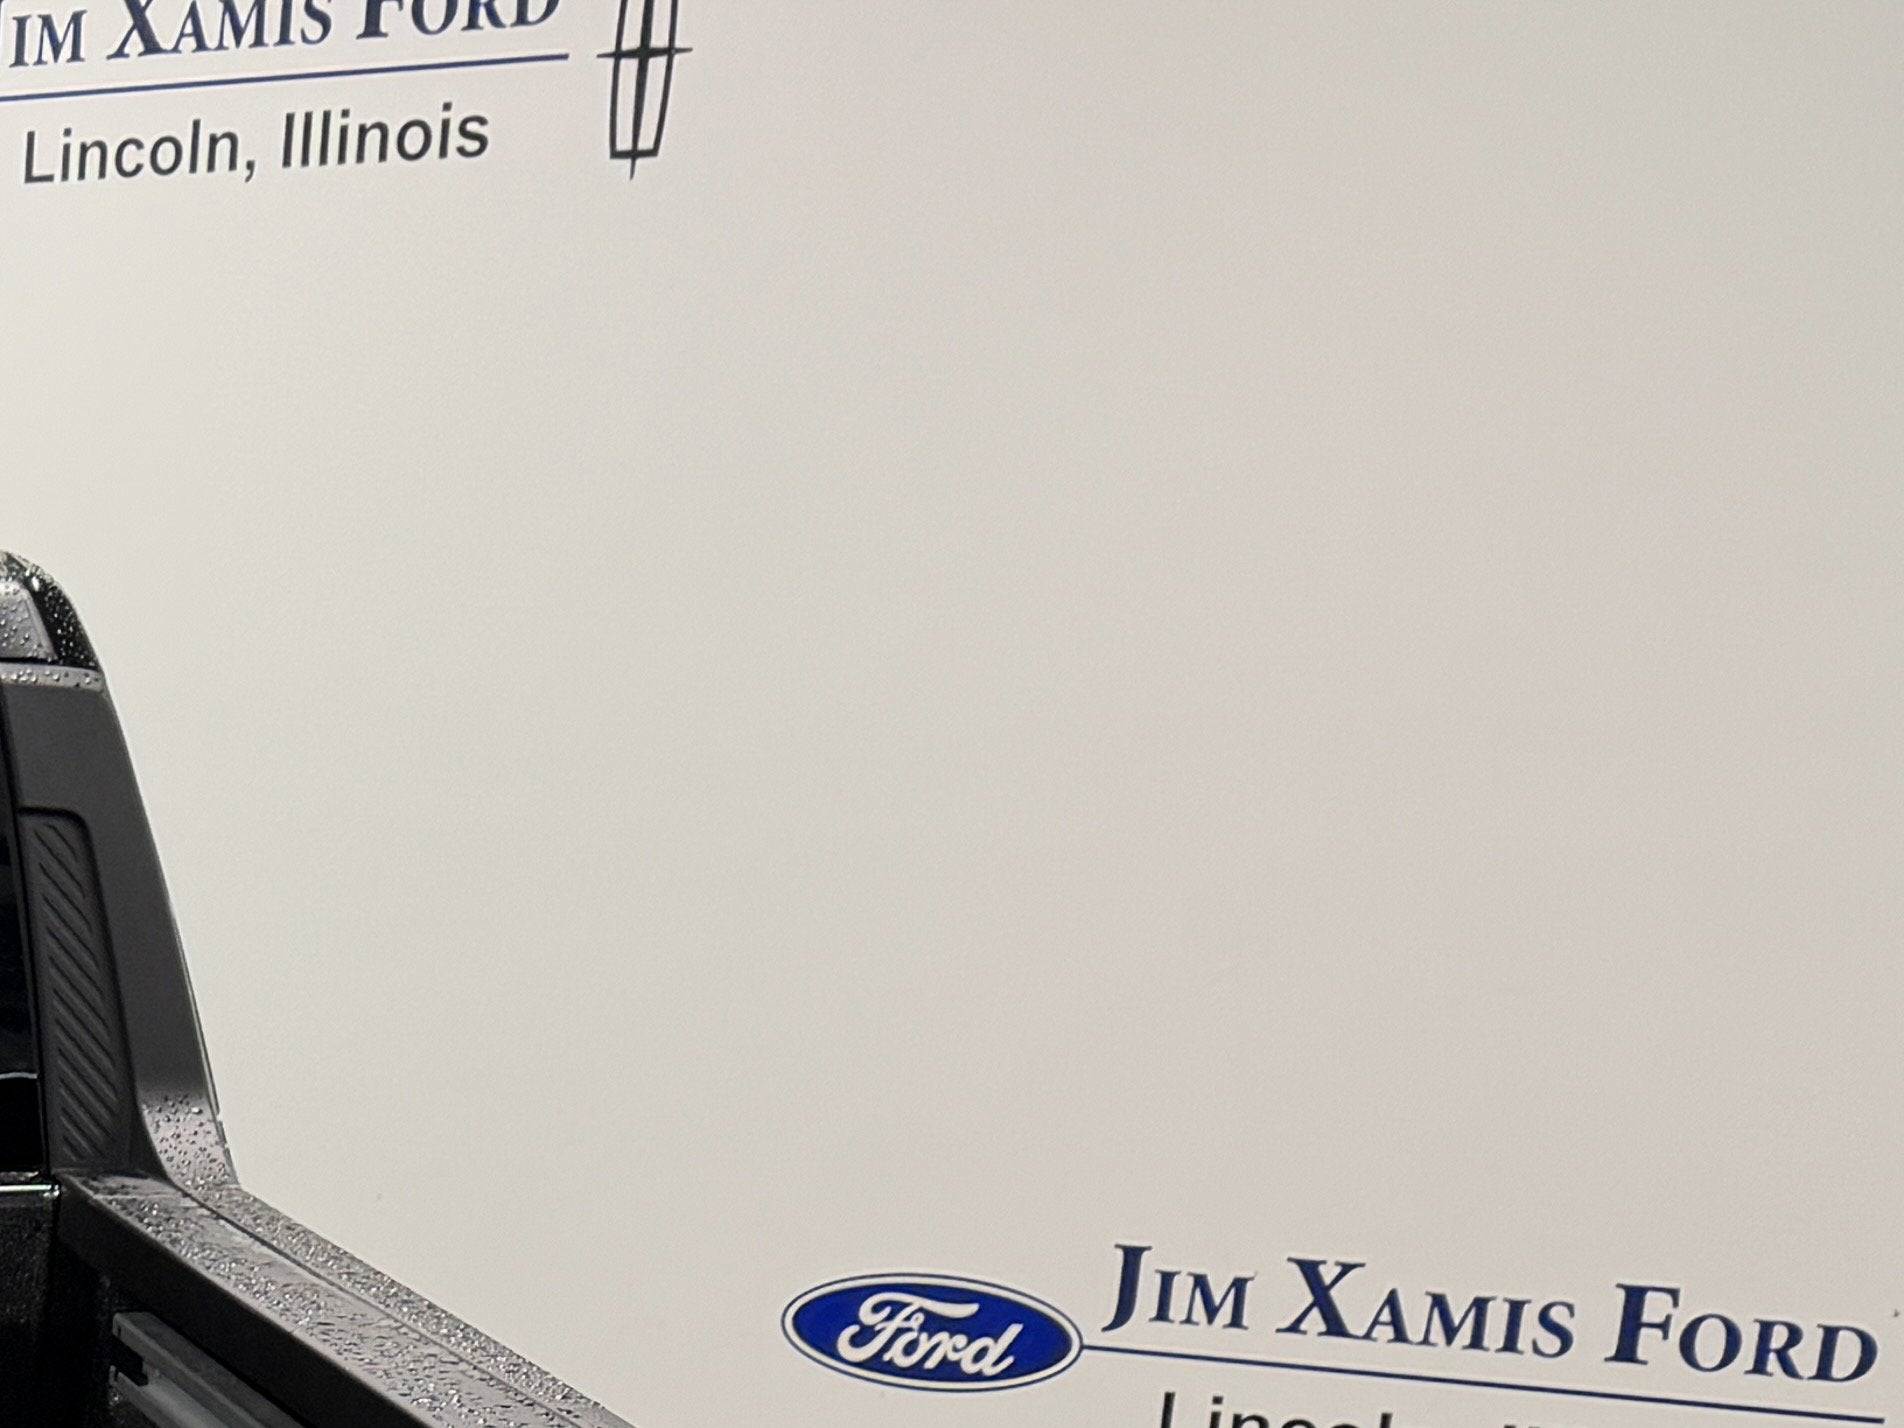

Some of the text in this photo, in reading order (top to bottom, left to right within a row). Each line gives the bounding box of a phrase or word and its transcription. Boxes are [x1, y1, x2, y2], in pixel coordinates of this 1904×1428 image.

[105, 0, 333, 61] XAMIS
[23, 100, 490, 184] Lincoln, Illinois
[836, 1292, 1023, 1377] Ford
[1100, 1242, 1879, 1385] JIM XAMIS FORD
